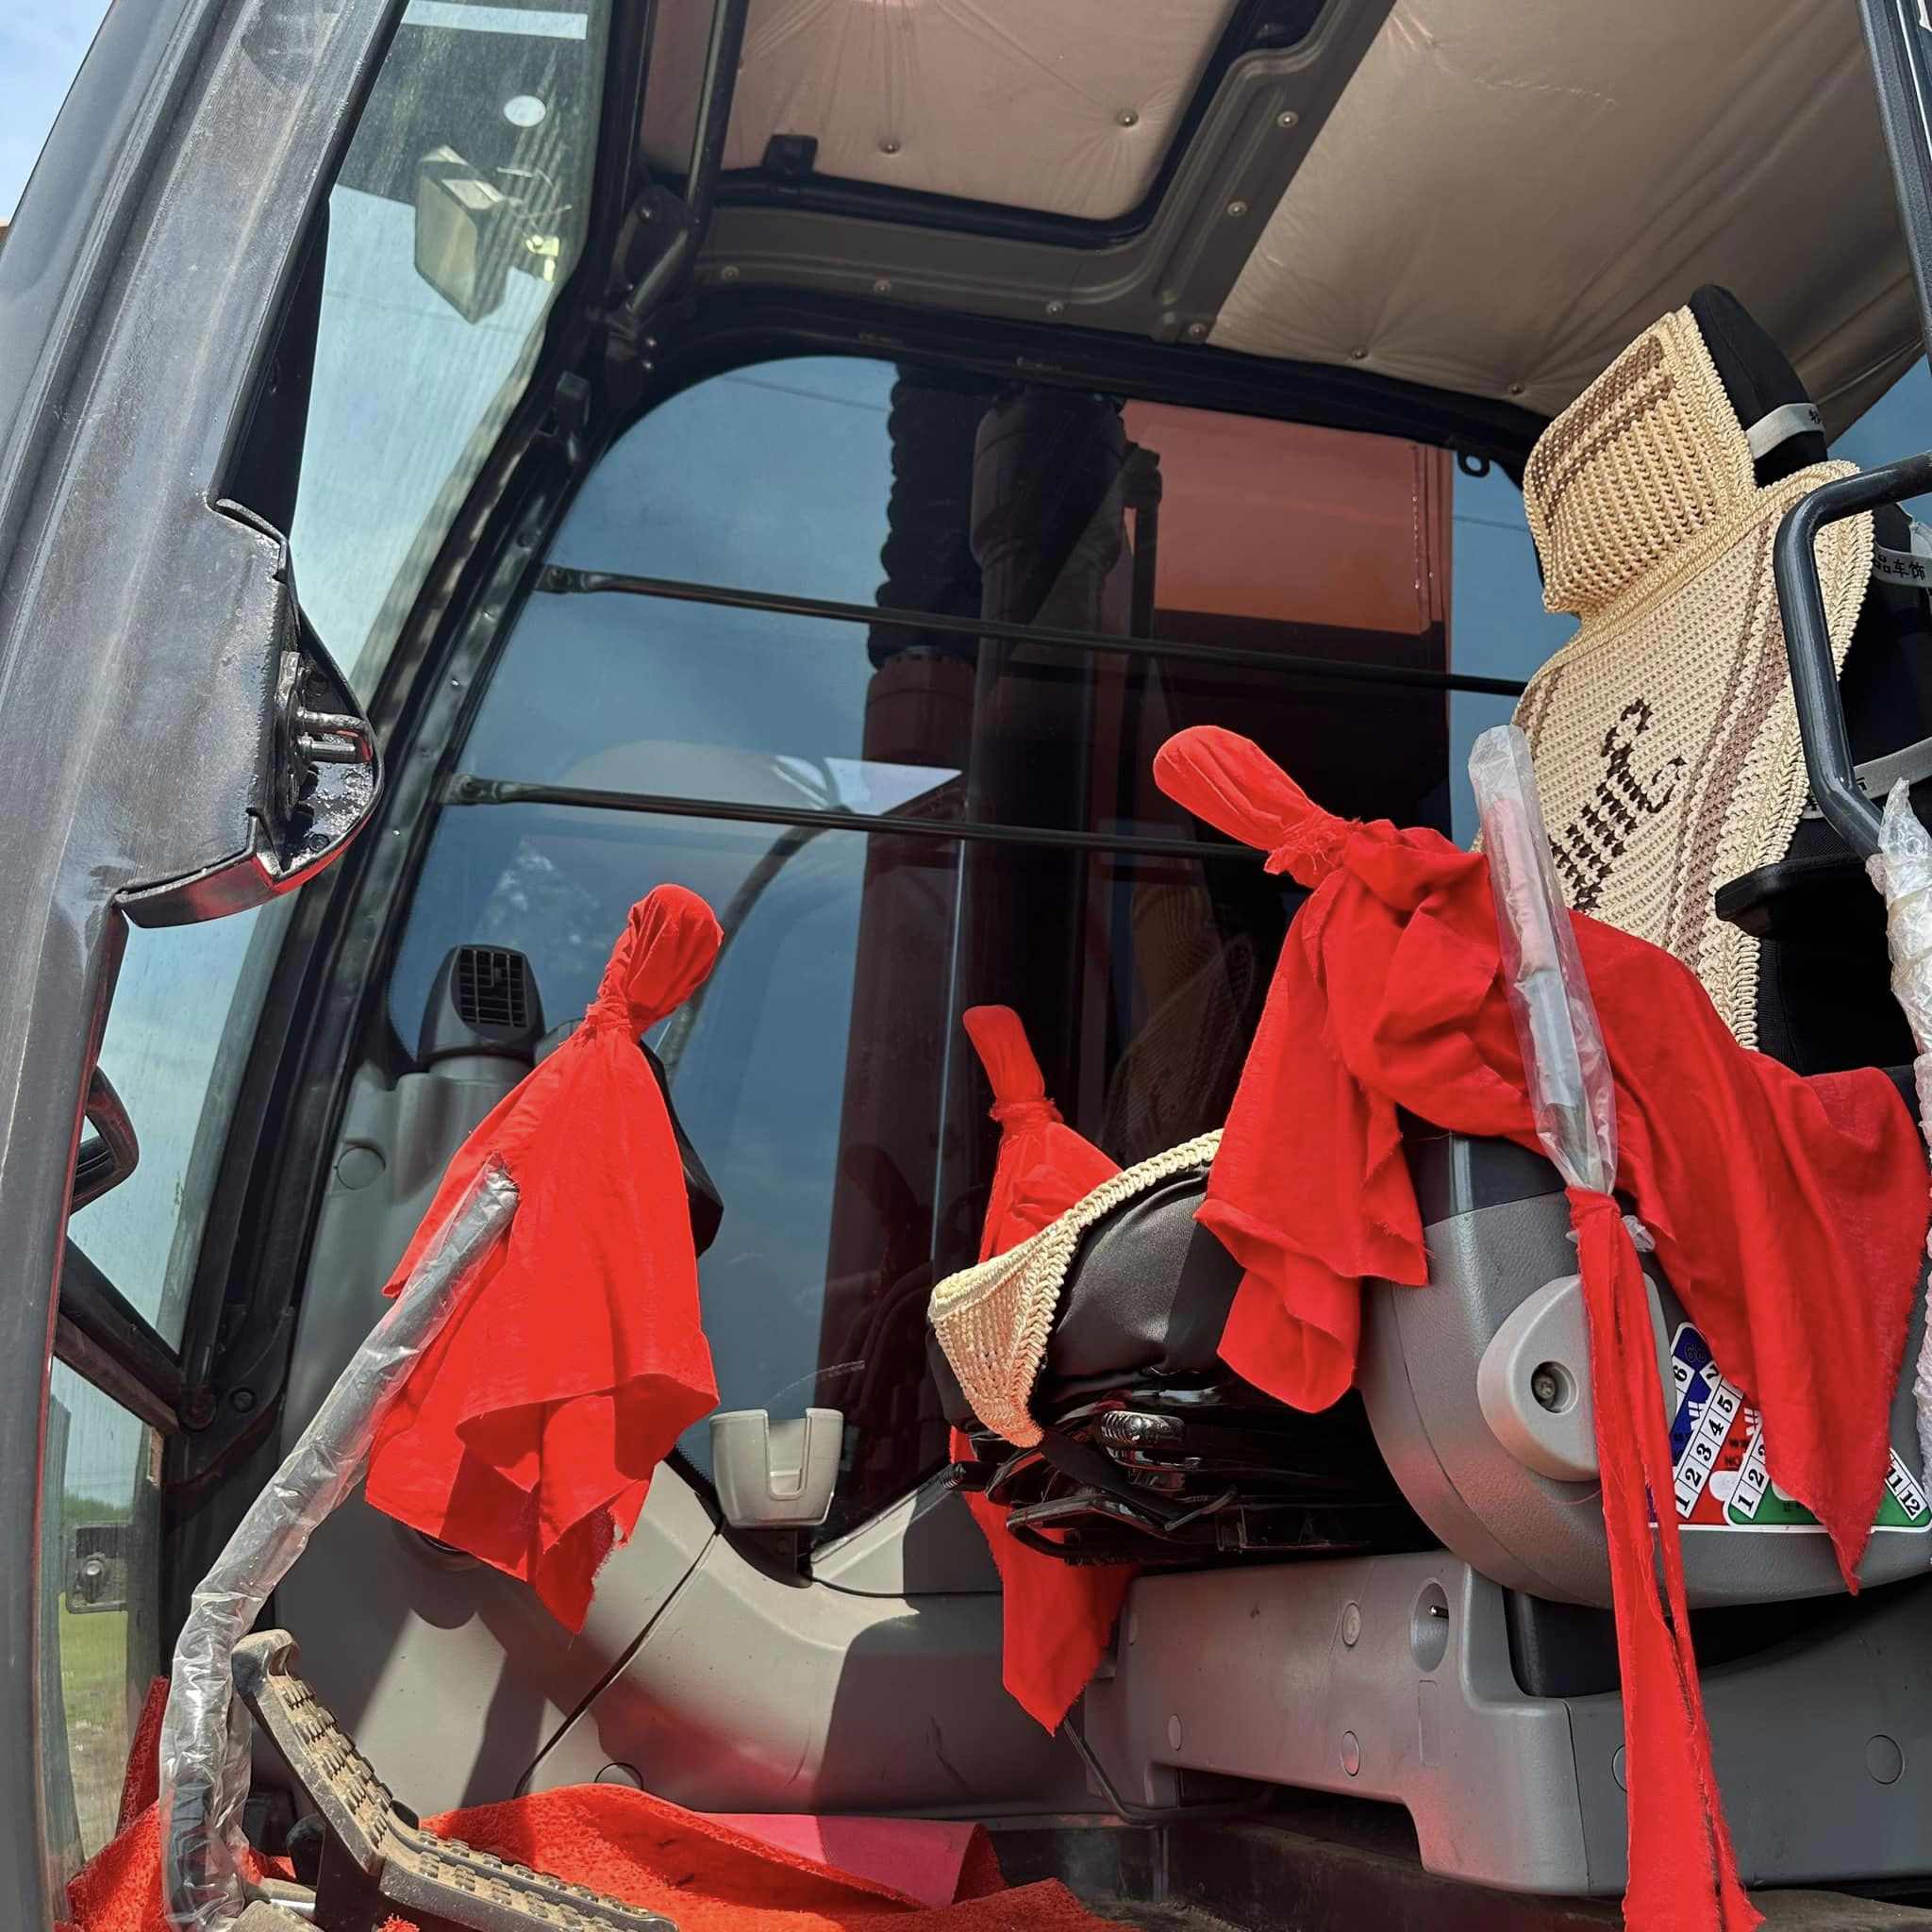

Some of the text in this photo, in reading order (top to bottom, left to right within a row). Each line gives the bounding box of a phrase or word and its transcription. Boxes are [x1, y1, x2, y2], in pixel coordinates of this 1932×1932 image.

[1673, 1365, 1687, 1382] 6
[1706, 1364, 1720, 1380] 7
[1686, 1468, 1702, 1487] 2
[1696, 1443, 1711, 1461] 3
[1708, 1419, 1724, 1437] 4
[1717, 1394, 1733, 1413] 5
[1739, 1494, 1754, 1511] 1
[1749, 1468, 1765, 1488] 2
[1900, 1491, 1921, 1516] 12
